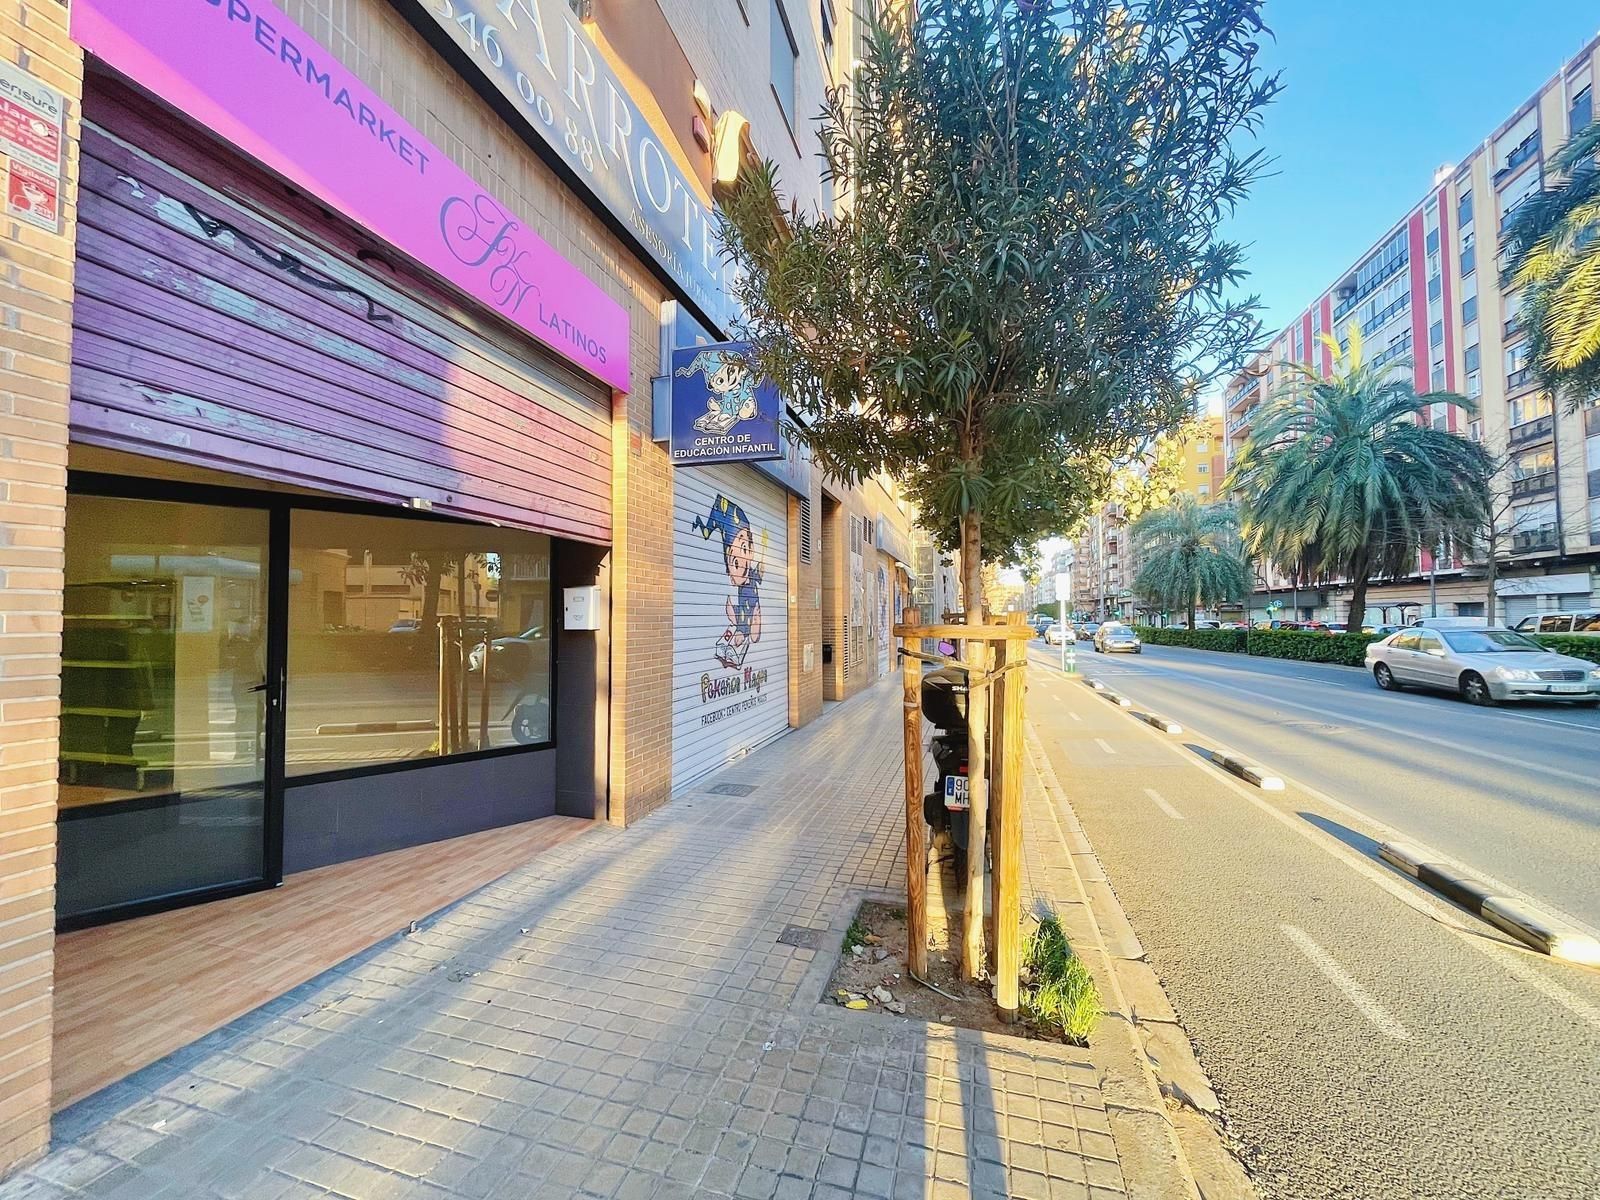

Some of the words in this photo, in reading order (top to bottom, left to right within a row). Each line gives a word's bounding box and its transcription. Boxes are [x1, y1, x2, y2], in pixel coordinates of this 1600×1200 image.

[516, 71, 554, 126] 00
[564, 117, 594, 173] 88
[538, 303, 607, 364] LATINOS
[674, 445, 730, 458] EDUCACIÓN
[732, 443, 776, 454] INFANTIL
[694, 435, 735, 446] CENTRO
[737, 434, 751, 443] DE
